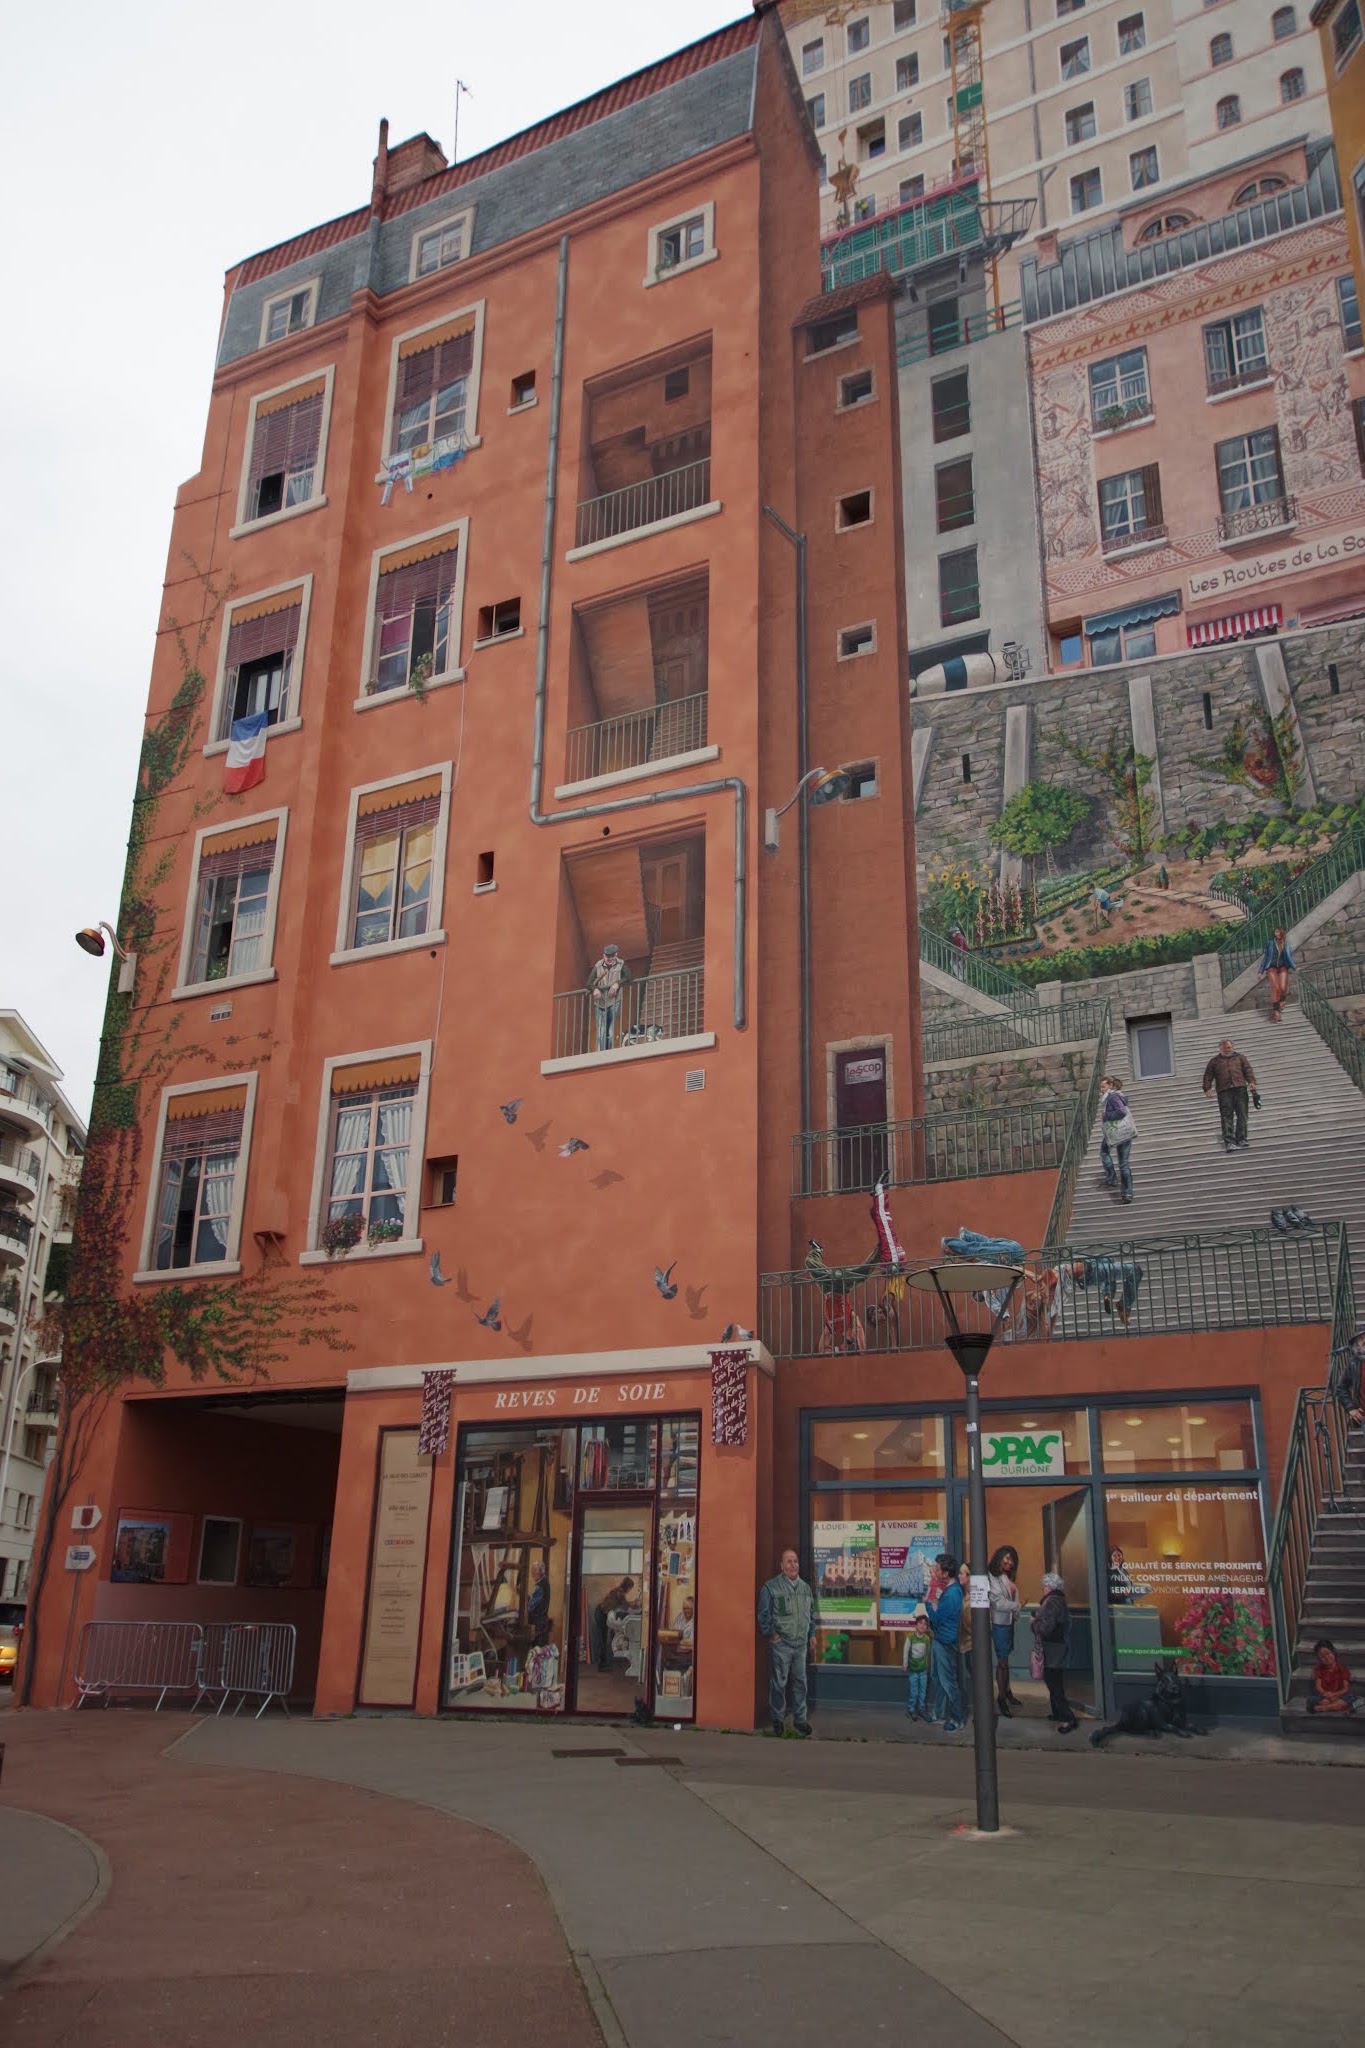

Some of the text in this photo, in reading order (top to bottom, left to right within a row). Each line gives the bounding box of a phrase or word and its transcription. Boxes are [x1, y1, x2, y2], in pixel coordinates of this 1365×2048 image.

[1189, 576, 1219, 593] Les
[1222, 558, 1287, 585] Routes
[1292, 550, 1313, 567] de
[494, 1383, 666, 1408] REVES DE SOIE
[1120, 1491, 1163, 1503] bailleur
[1166, 1491, 1180, 1502] du
[1183, 1490, 1258, 1503] département
[887, 1521, 918, 1529] VENDRE
[1122, 1560, 1159, 1570] QUALITÉ
[1161, 1561, 1173, 1570] DE
[1175, 1561, 1212, 1570] SERVICE
[1213, 1560, 1263, 1571] PROXIMITÉ
[1136, 1574, 1206, 1582] CONSTRUCTEUR
[1208, 1573, 1264, 1583] AMÉNAGEUR
[1182, 1586, 1220, 1595] HABITAT
[1221, 1587, 1266, 1596] DURABLE
